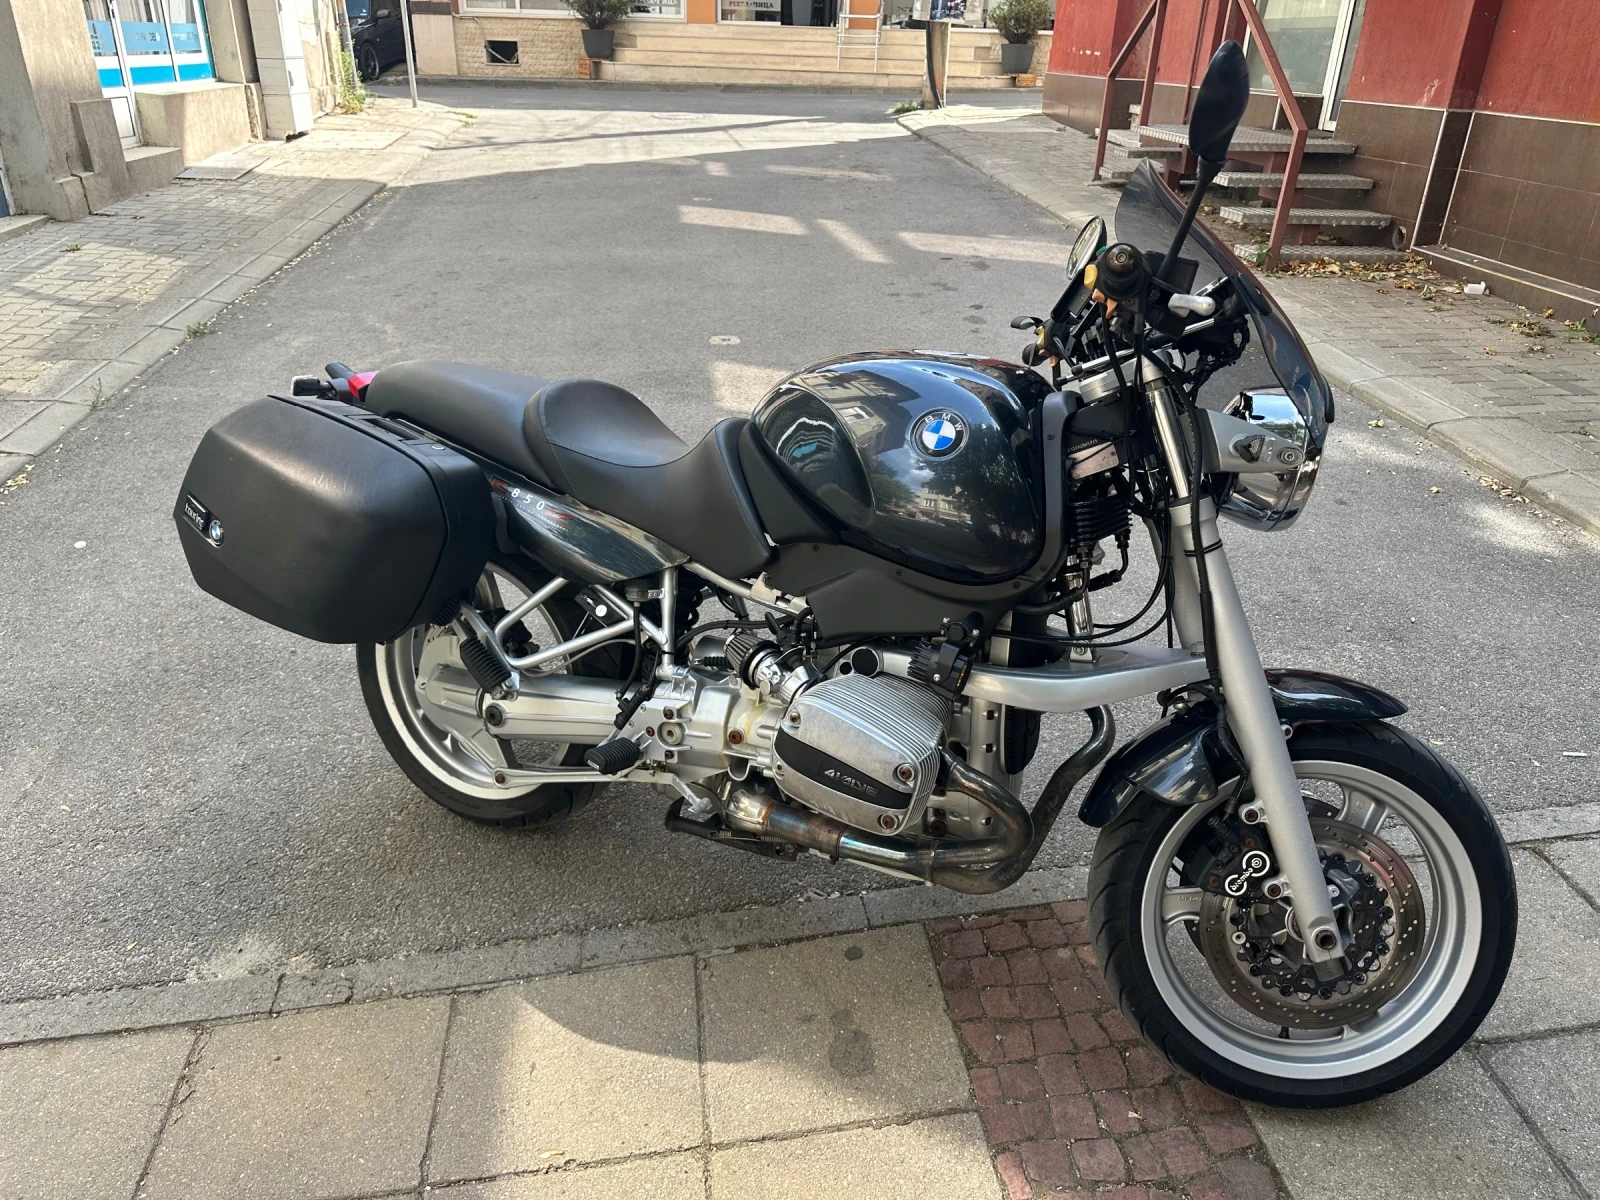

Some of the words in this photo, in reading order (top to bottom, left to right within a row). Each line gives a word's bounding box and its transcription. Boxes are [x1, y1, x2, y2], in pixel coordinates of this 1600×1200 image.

[925, 413, 963, 430] BMW
[511, 488, 545, 510] 850
[1230, 868, 1253, 891] brembo
